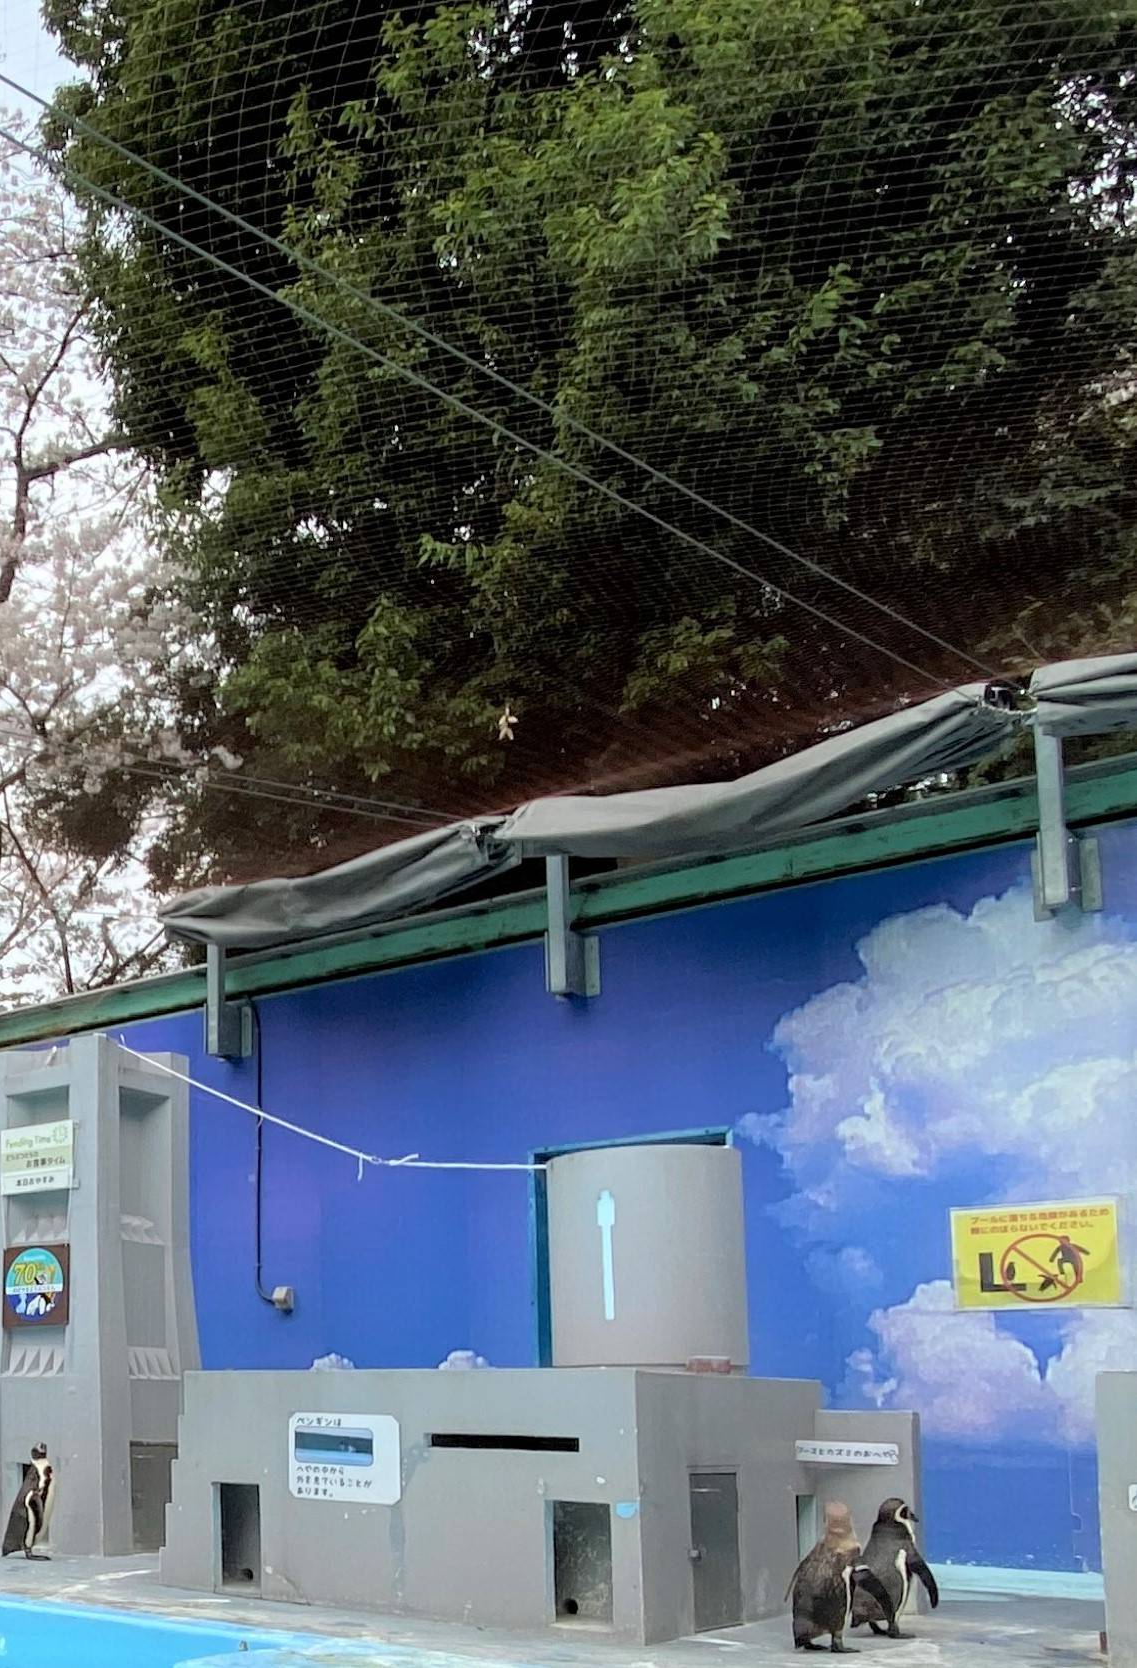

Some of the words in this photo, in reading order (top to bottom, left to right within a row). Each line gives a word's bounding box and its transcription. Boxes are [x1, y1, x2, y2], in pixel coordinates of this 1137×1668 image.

[34, 1135, 51, 1145] Time
[296, 1415, 342, 1427] ペンギンは
[296, 1465, 345, 1475] へやの中から
[296, 1487, 334, 1498] あります。
